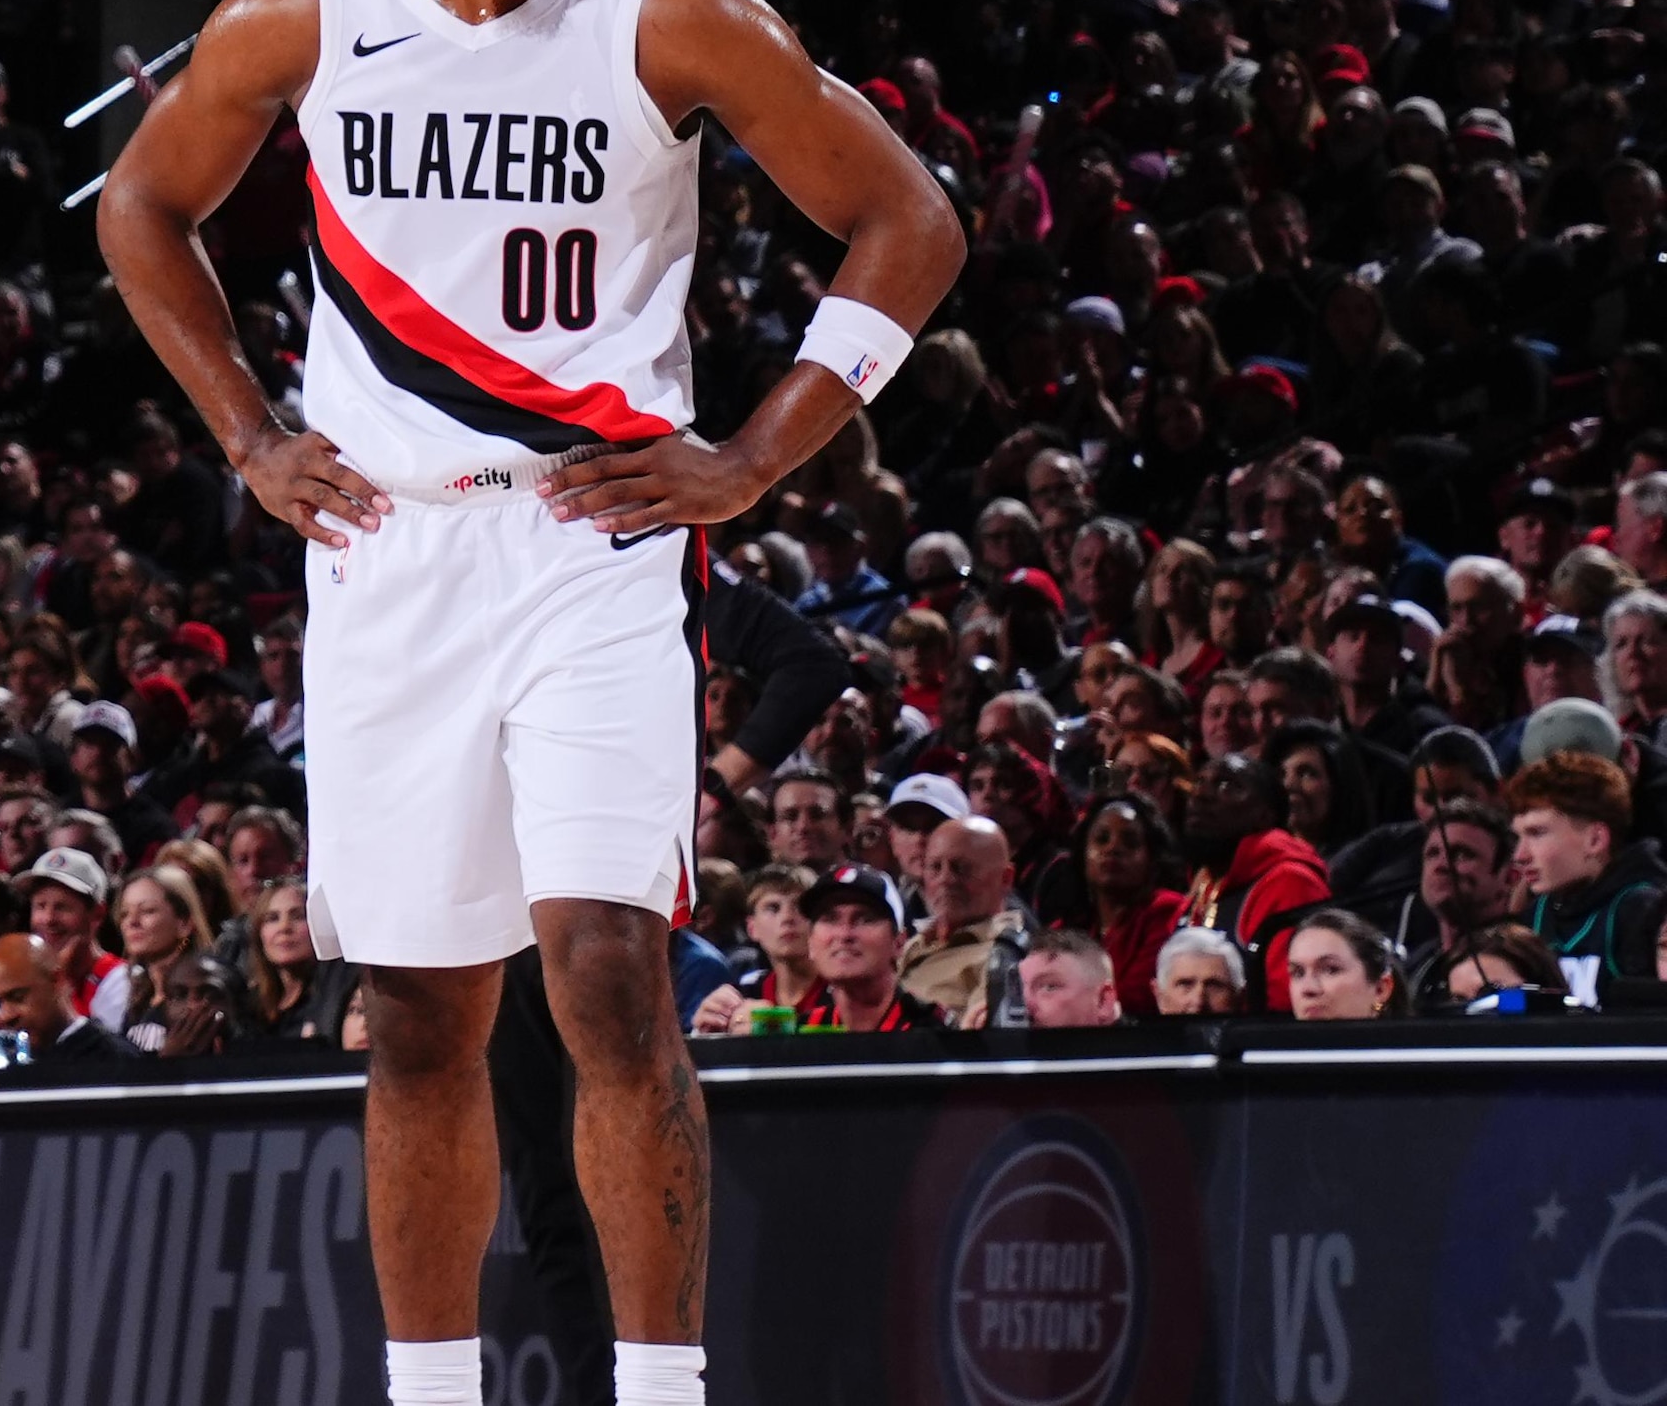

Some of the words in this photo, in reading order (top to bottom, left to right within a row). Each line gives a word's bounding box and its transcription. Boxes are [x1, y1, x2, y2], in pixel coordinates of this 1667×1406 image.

[337, 111, 608, 204] BLAZERS
[503, 227, 597, 332] 00
[983, 1240, 1106, 1292] DETROIT
[978, 1298, 1106, 1352] PISTONS
[1270, 1230, 1357, 1406] VS
